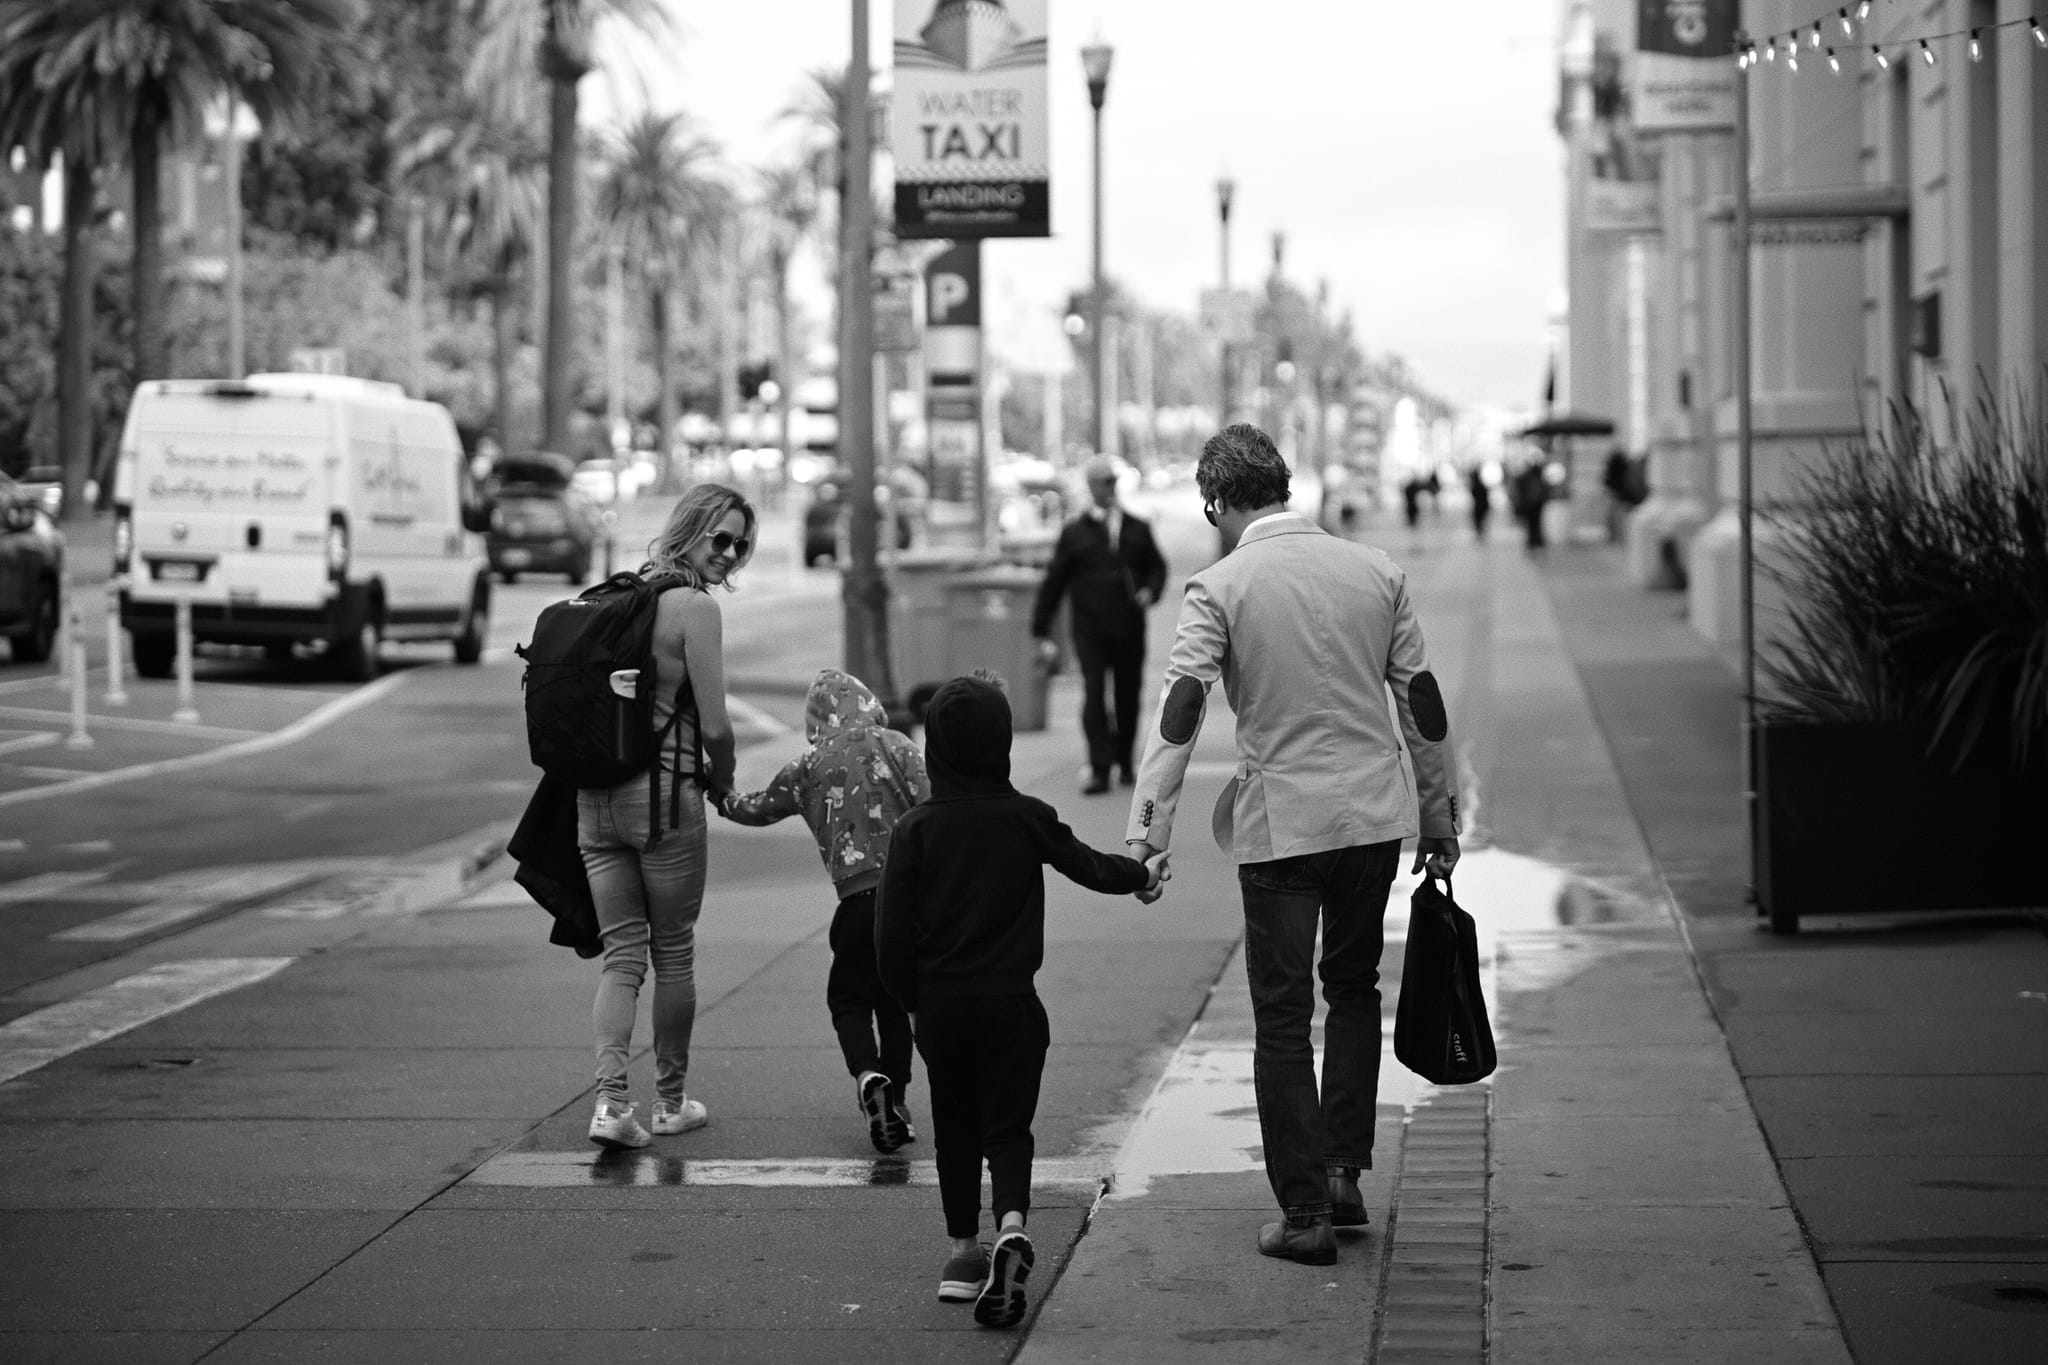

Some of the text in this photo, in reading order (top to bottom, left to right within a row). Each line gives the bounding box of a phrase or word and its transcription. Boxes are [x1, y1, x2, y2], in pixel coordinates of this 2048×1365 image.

[919, 88, 1024, 114] WATER
[921, 124, 1020, 160] TAXI
[917, 183, 1025, 208] LANDING
[931, 271, 969, 321] P
